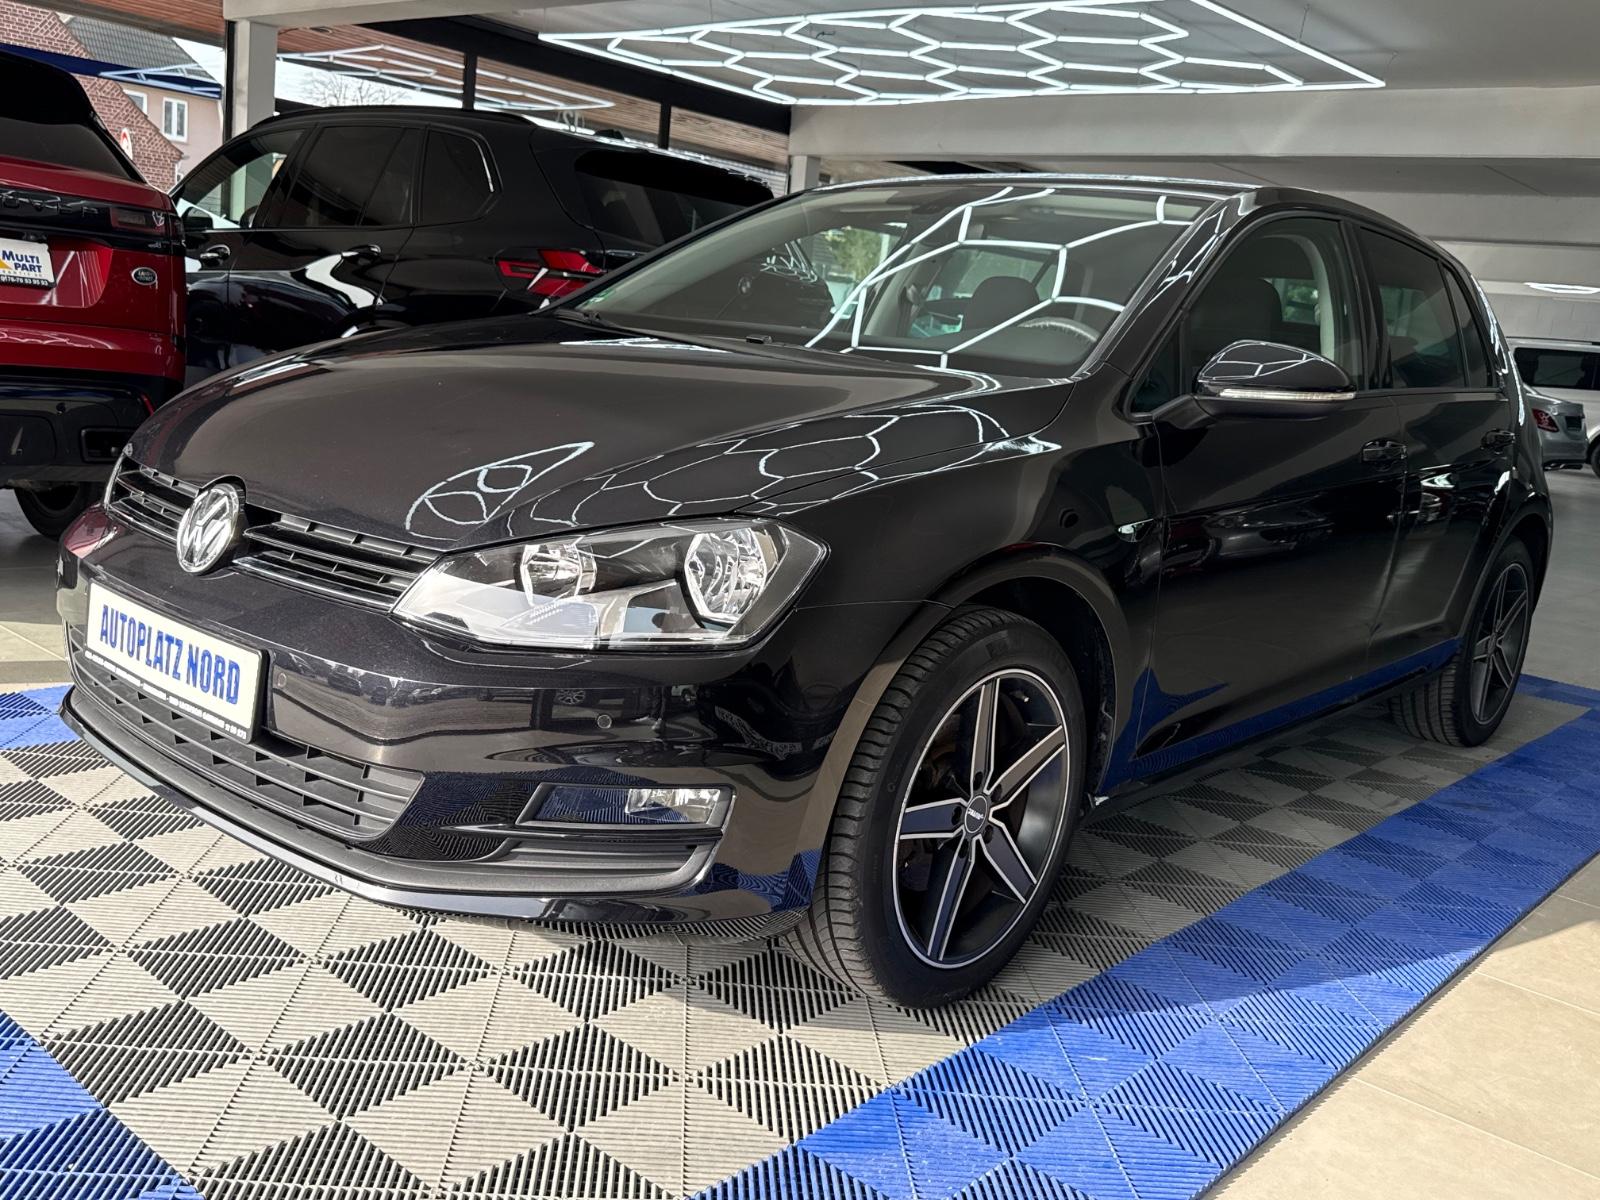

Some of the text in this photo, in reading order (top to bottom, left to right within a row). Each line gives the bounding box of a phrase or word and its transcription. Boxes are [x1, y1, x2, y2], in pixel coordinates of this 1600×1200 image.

[2, 250, 40, 264] MULTI
[14, 262, 42, 273] PART
[100, 604, 240, 705] AUTOPLATZ NORD
